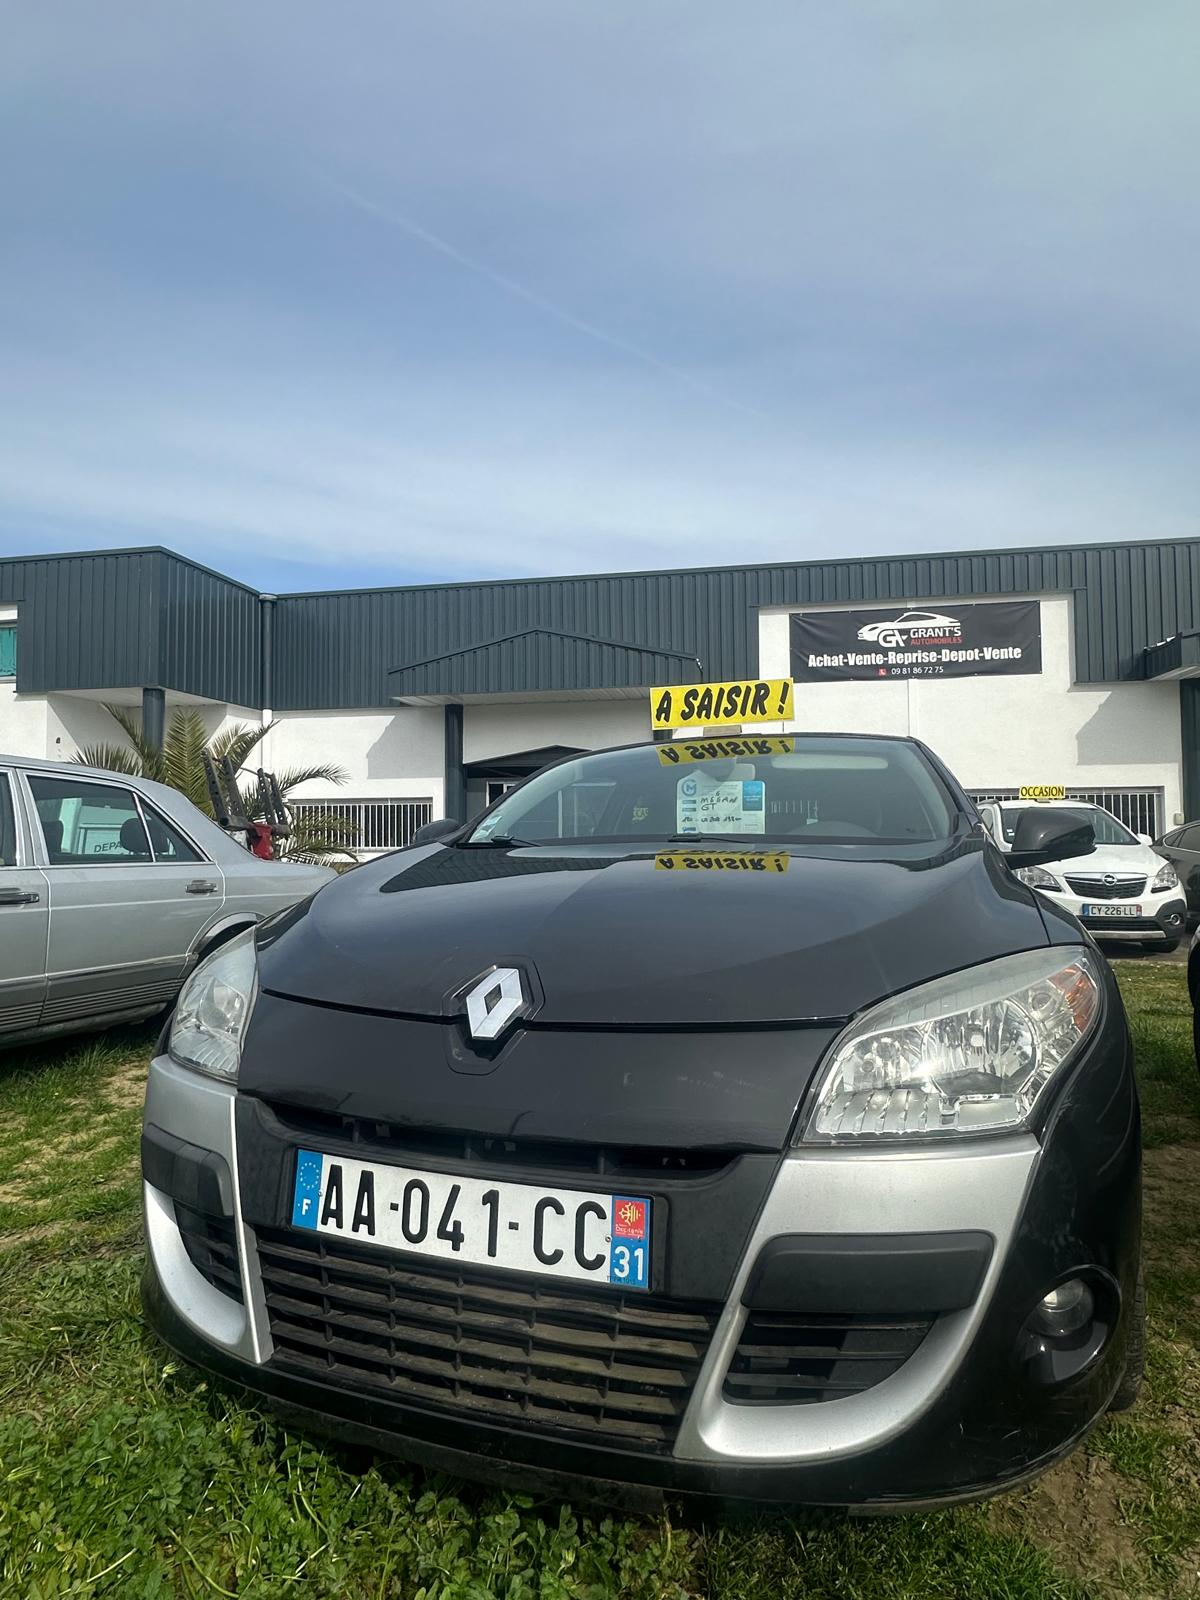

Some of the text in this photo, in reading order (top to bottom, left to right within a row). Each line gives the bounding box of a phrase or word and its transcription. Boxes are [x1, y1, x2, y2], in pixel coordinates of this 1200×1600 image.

[910, 626, 962, 638] GRANT'S
[911, 637, 962, 645] AUTOMOBILES
[902, 667, 911, 675] 81
[924, 666, 933, 674] 72
[655, 690, 673, 723] A
[680, 682, 771, 721] SAISIR
[1020, 786, 1065, 798] OCCASION
[301, 1198, 312, 1216] F
[613, 1245, 644, 1281] 31
